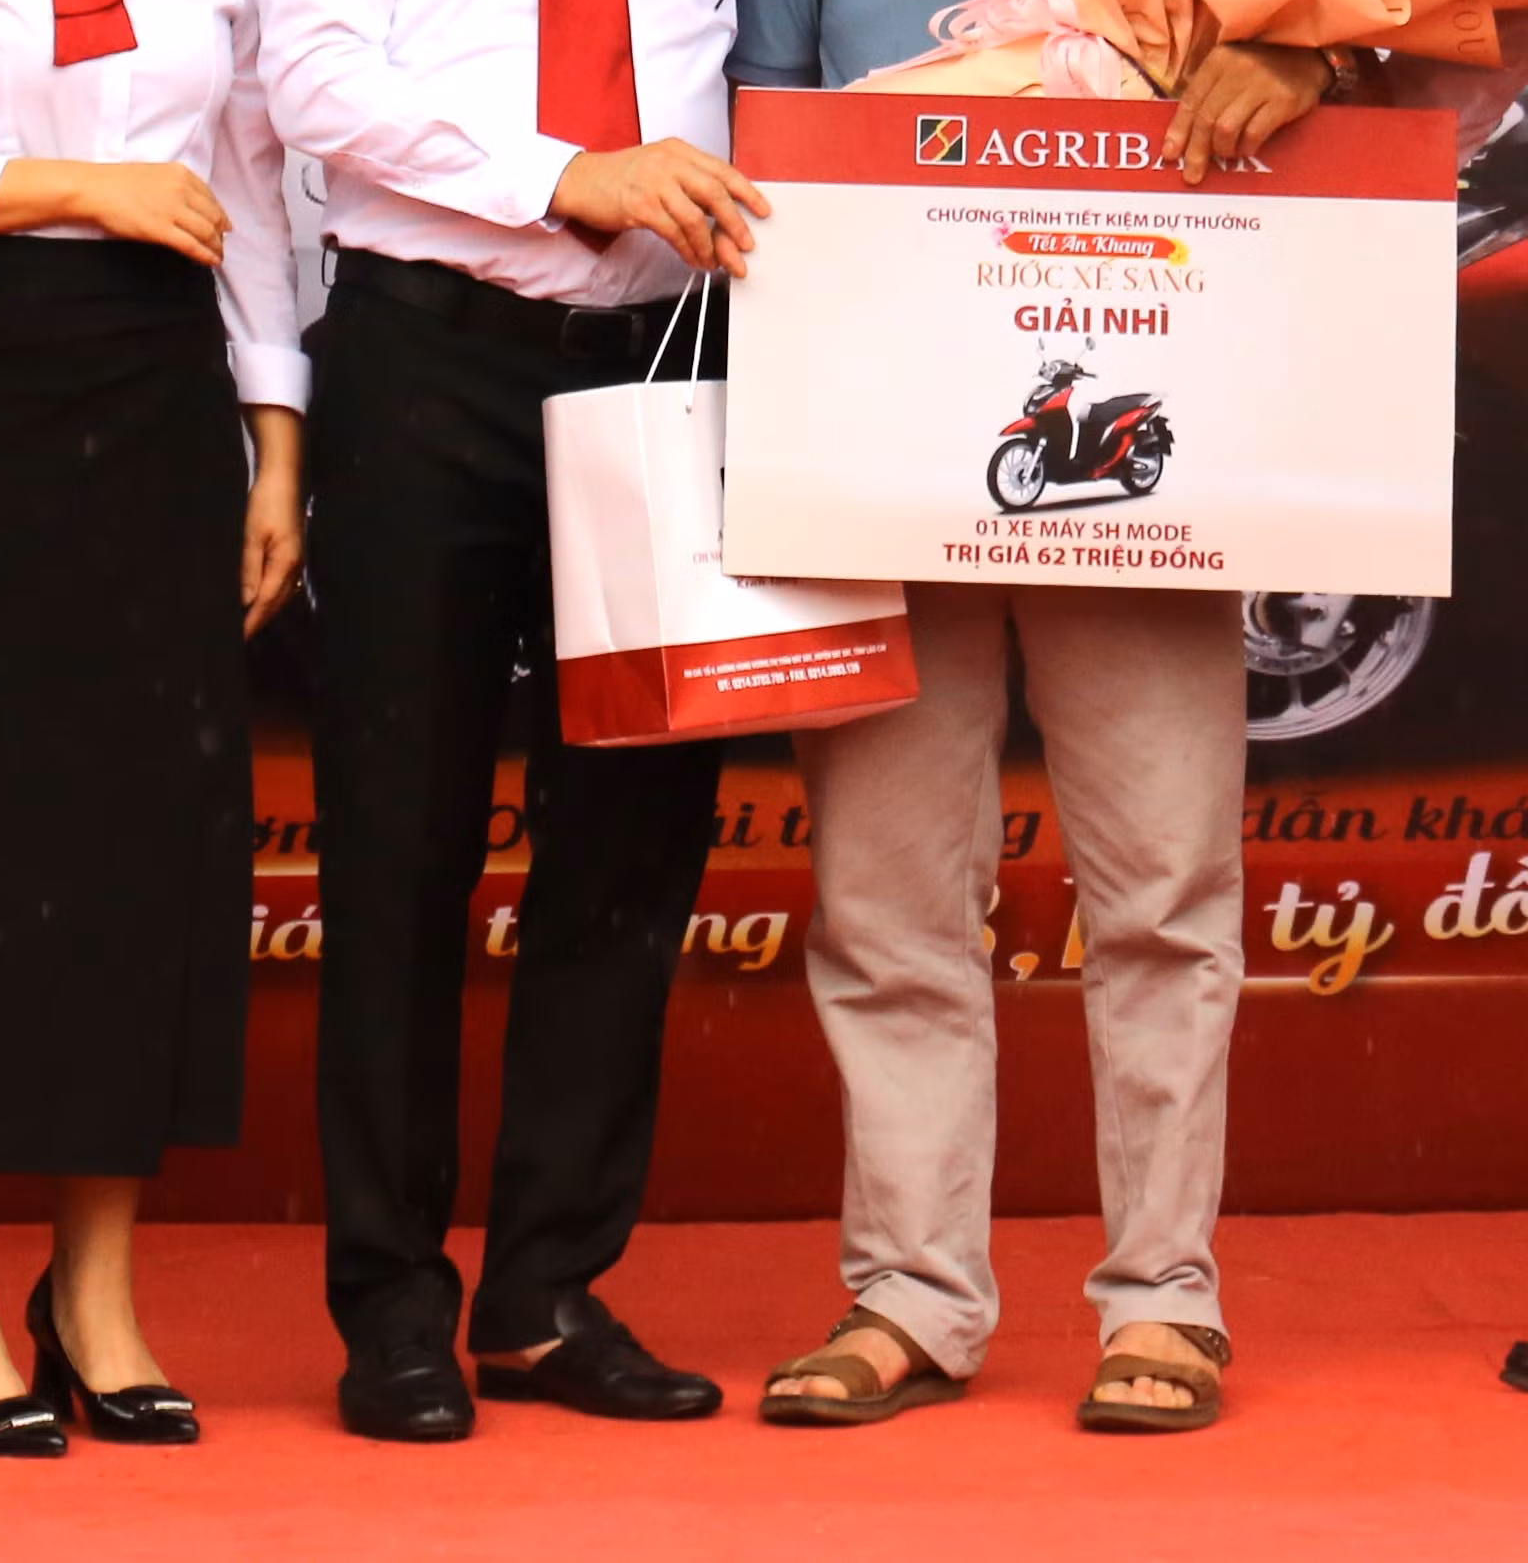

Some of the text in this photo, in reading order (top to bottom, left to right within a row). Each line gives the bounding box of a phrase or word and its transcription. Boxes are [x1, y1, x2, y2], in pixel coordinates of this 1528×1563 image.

[976, 129, 1272, 173] AGRIB
[926, 206, 1261, 233] CHƯƠNG TRÌNH TIẾT KIỆM DỰ THƯỞNG
[1060, 235, 1088, 252] An
[1092, 235, 1155, 258] Khang
[977, 257, 1205, 294] RƯỚC XẾ SANG
[1013, 297, 1170, 336] GIẢI NHÌ
[975, 518, 1193, 542] 01 XE MÁY SH MODE
[943, 542, 1224, 573] TRỊ GIÁ 62 TRIỆU ĐỒNG
[1263, 880, 1394, 995] tỷ
